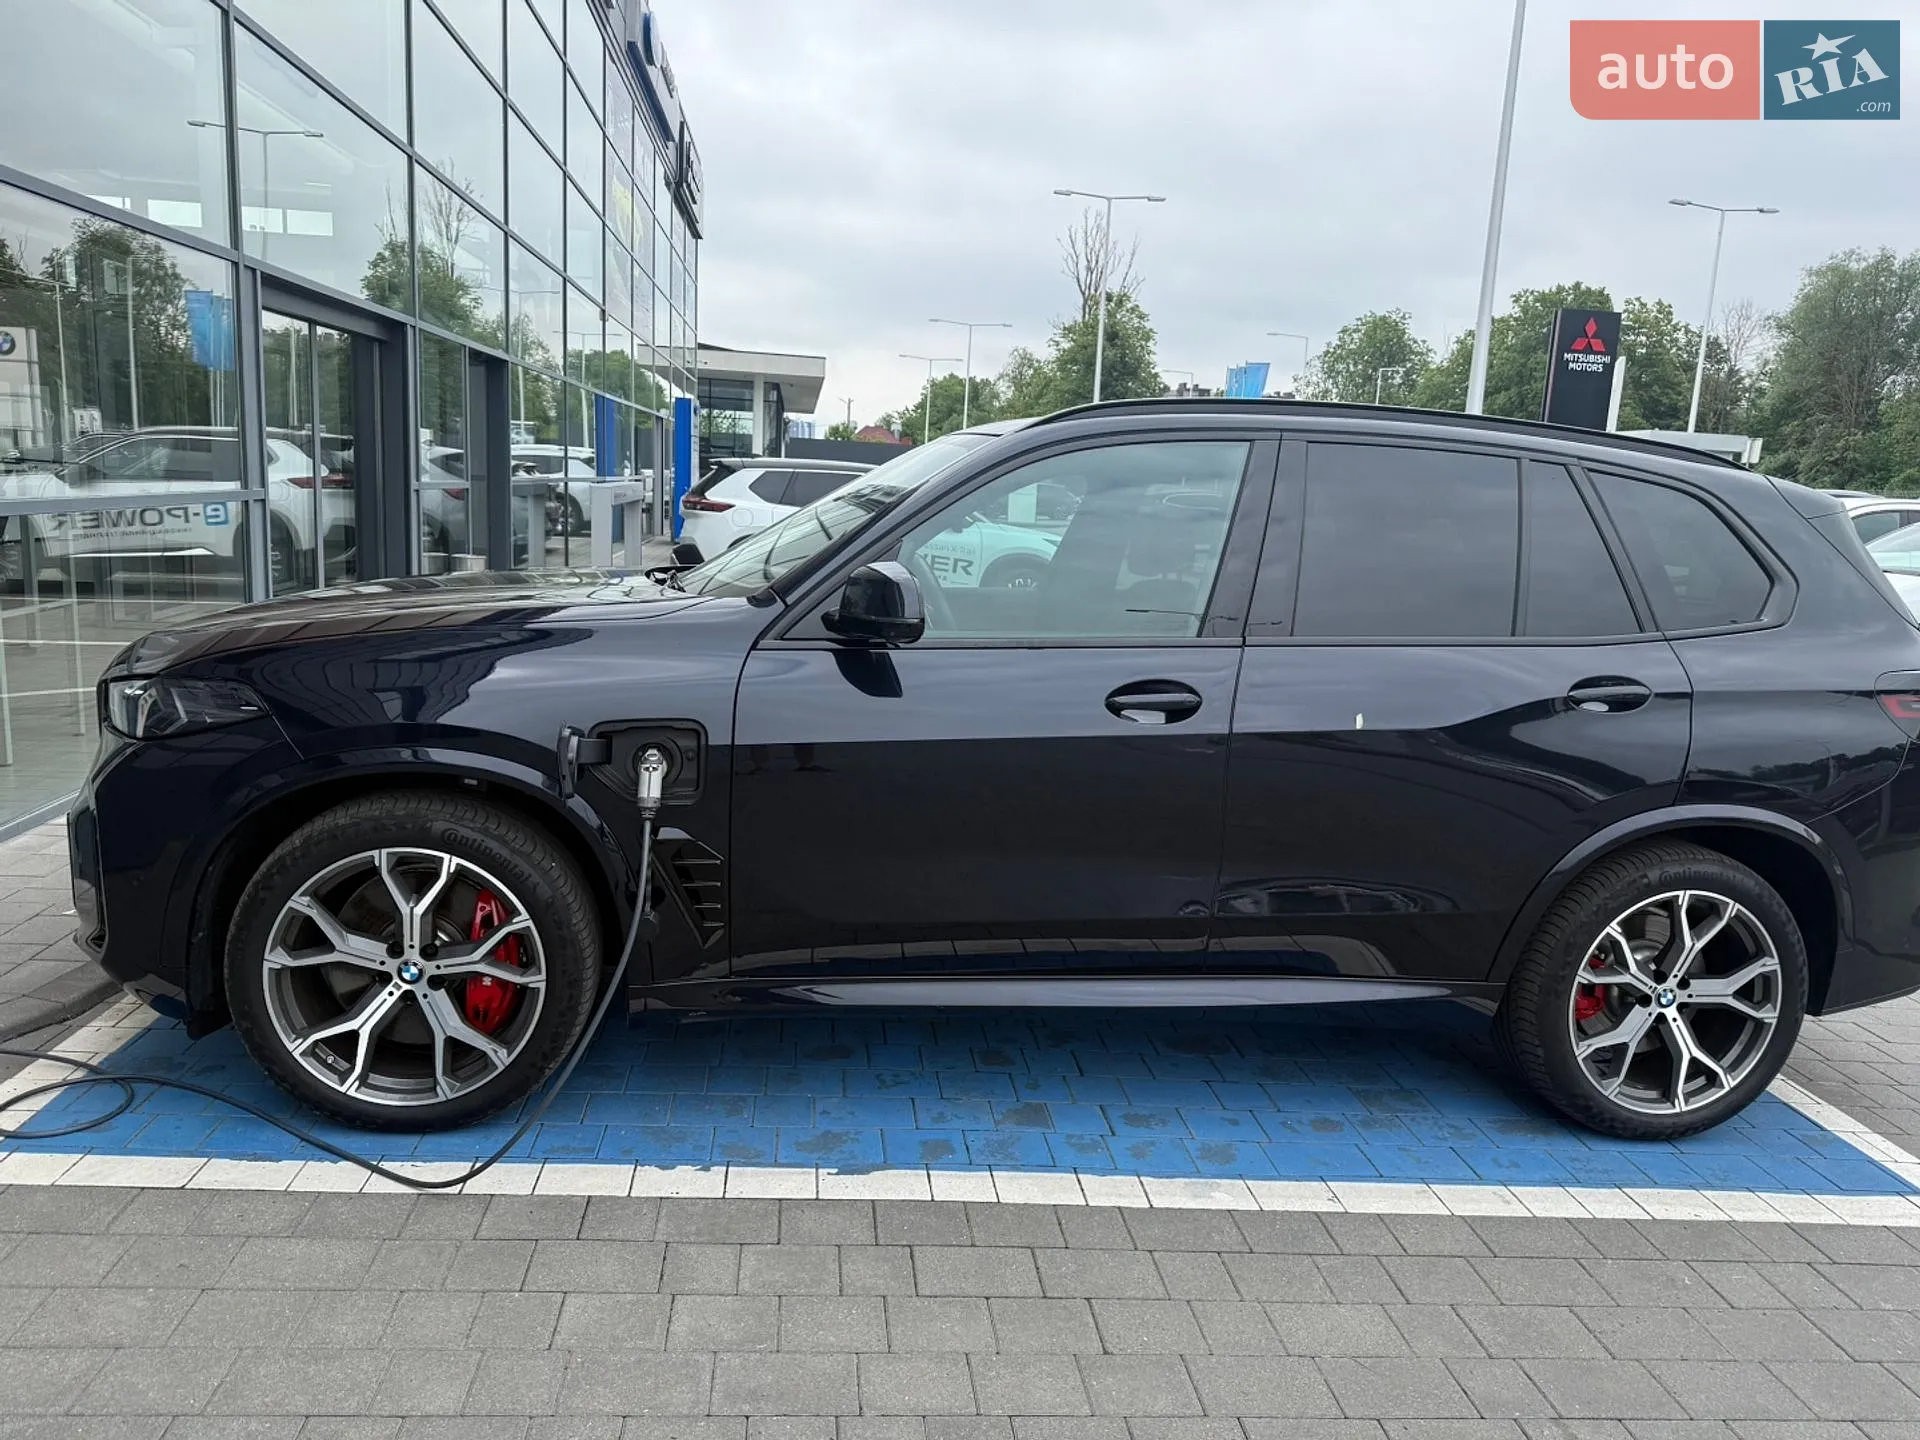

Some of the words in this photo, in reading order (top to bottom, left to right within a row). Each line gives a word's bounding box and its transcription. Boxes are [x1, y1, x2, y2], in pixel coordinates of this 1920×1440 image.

[1563, 353, 1611, 364] MITSUBISHI
[1568, 362, 1604, 372] MOTORS
[441, 828, 533, 883] Continental
